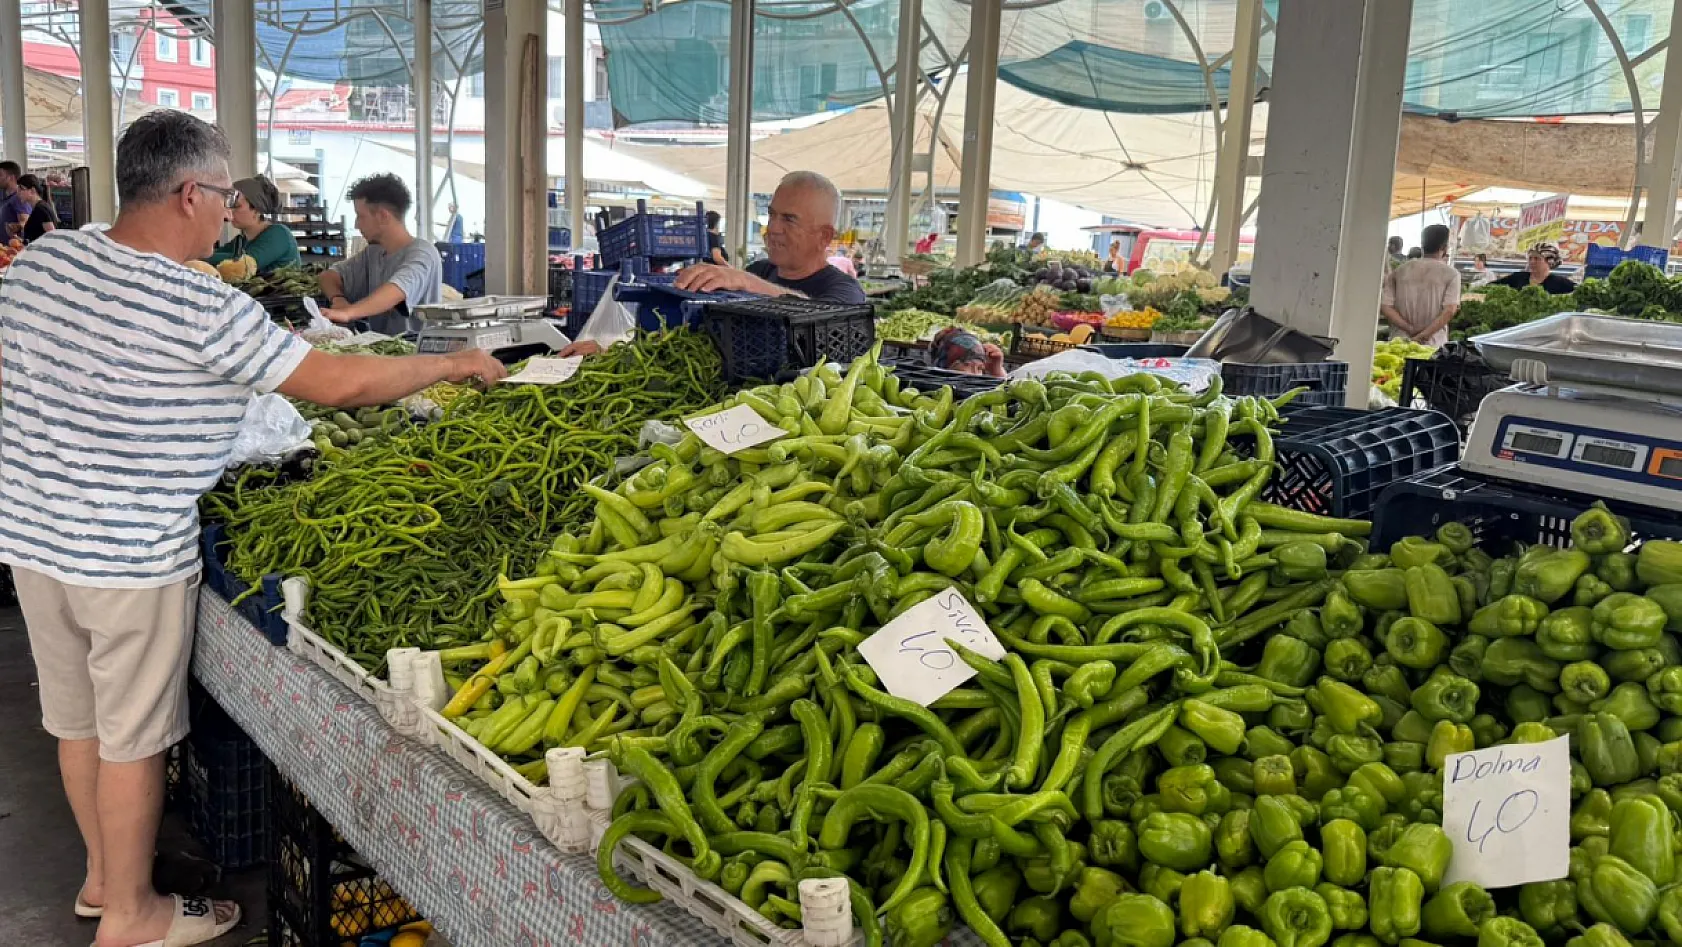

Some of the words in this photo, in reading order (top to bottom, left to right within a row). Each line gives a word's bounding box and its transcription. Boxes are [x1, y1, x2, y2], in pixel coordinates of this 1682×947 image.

[720, 423, 759, 444] 40
[899, 630, 955, 670] 40
[1452, 750, 1541, 784] Dolma
[1467, 788, 1539, 854] 40
